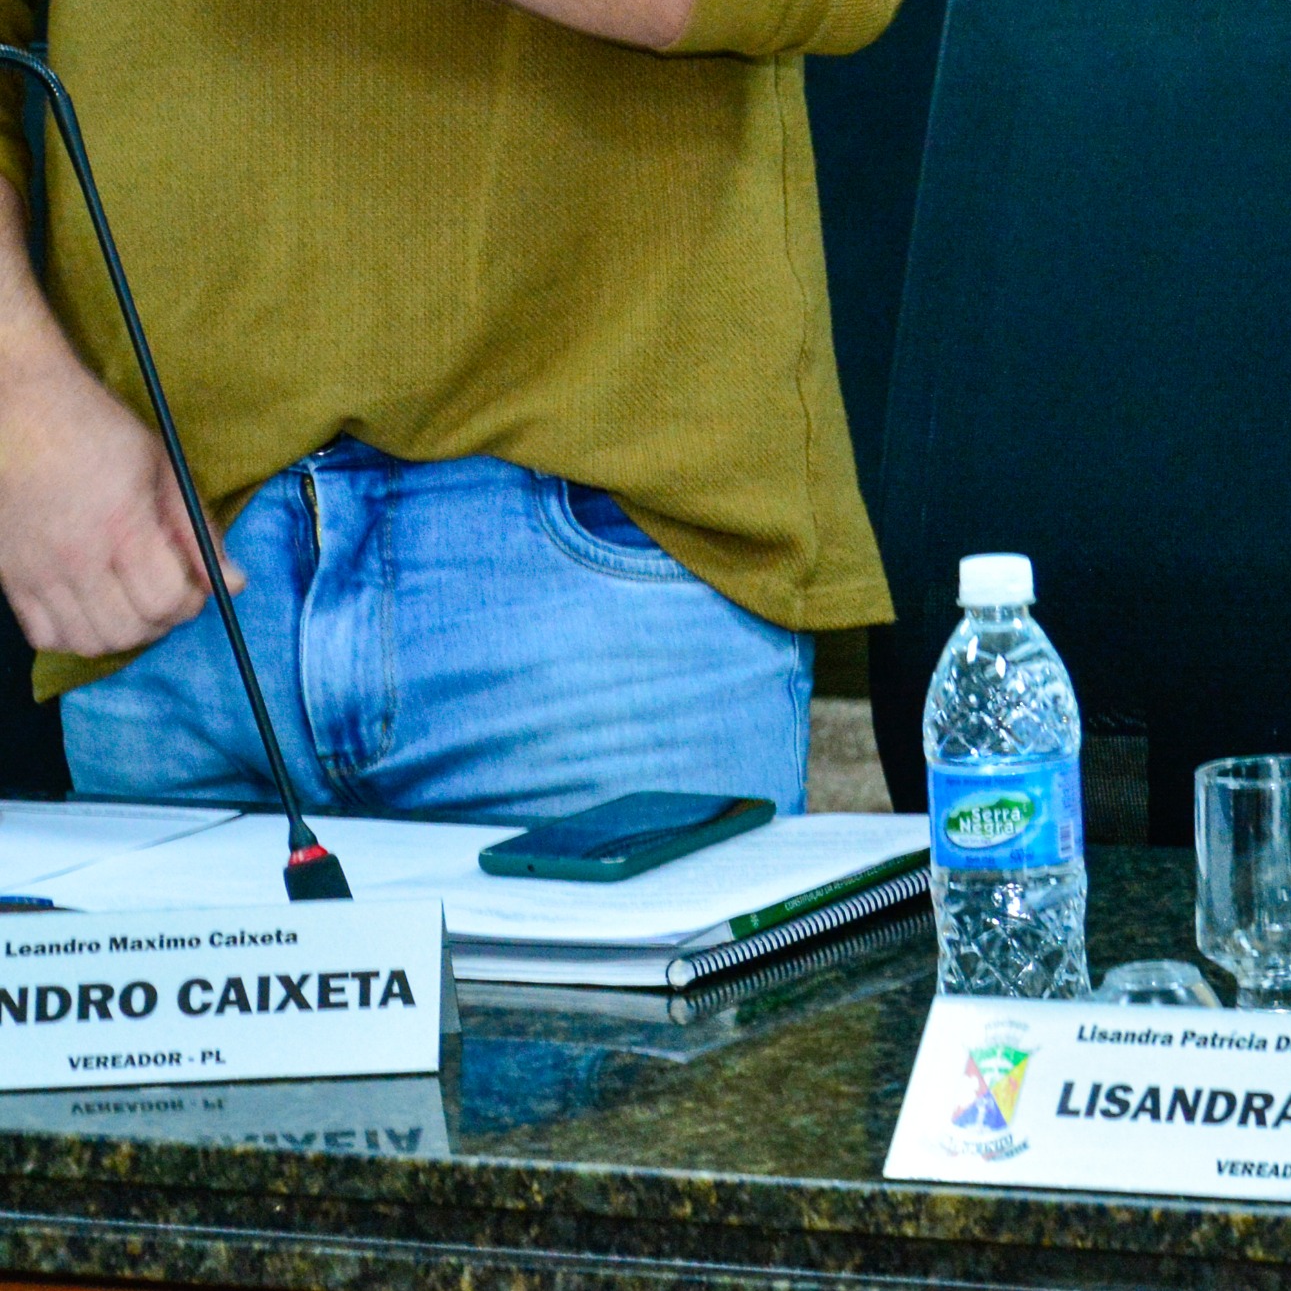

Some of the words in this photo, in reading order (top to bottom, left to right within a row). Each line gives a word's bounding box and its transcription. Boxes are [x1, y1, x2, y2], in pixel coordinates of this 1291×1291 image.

[971, 806, 1020, 823] Serra
[959, 817, 1015, 839] Negra
[5, 935, 100, 957] Leandro
[109, 933, 201, 952] Maximo
[209, 929, 298, 948] Caixeta
[176, 969, 416, 1016] CAIXETA
[1077, 1024, 1173, 1046] Lisandra
[1180, 1029, 1267, 1051] Patrícia
[68, 1051, 182, 1071] VEREADOR
[201, 1049, 226, 1065] PL
